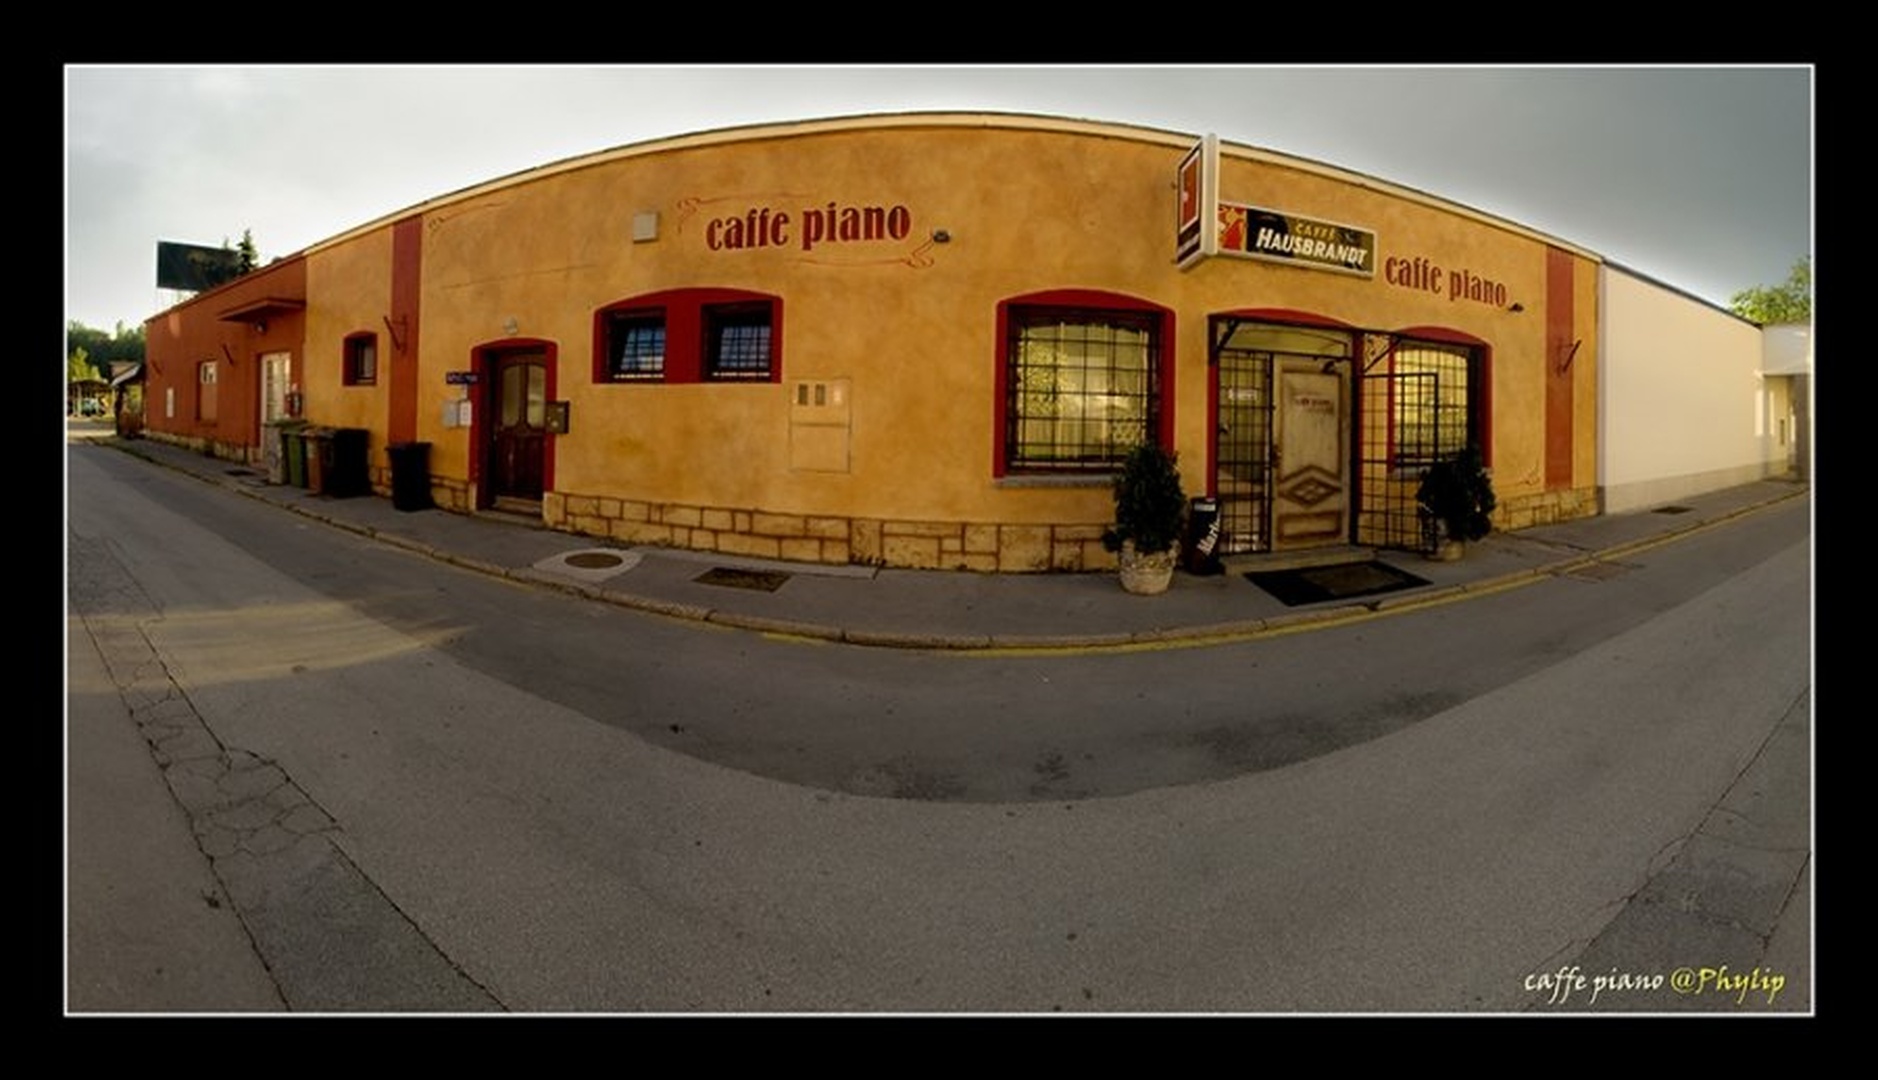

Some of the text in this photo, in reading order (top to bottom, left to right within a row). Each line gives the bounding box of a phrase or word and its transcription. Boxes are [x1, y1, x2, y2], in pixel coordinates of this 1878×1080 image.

[706, 202, 911, 251] caffe piano
[1256, 227, 1368, 265] HAUSBRANDT
[1385, 256, 1506, 307] caffe piano
